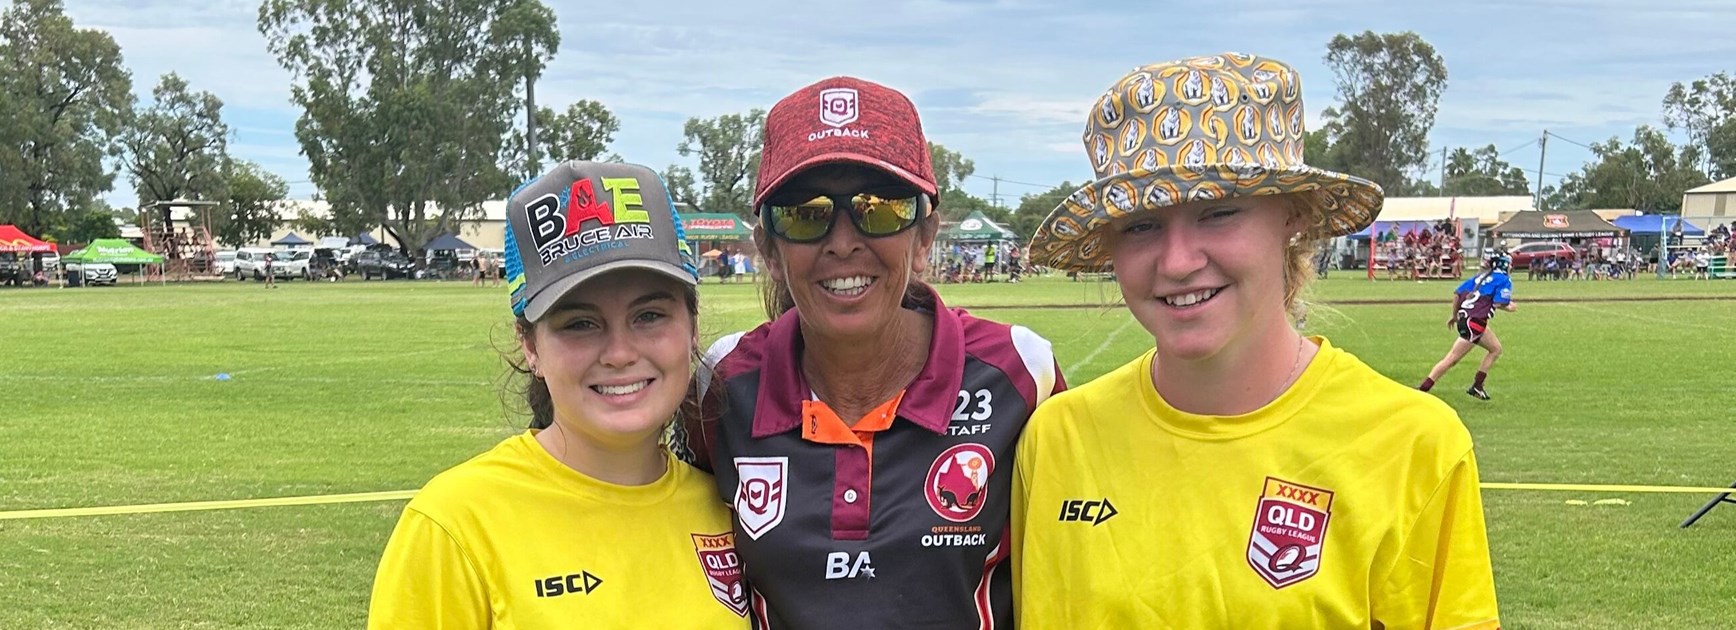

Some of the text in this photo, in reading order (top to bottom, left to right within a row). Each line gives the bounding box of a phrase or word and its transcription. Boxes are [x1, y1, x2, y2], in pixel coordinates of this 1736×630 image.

[808, 127, 869, 141] OUTBACK
[525, 176, 649, 252] BAE
[690, 219, 735, 229] TOYOTA
[540, 224, 653, 267] BRUCE AIR
[572, 240, 630, 260] ELECTRICAL
[1461, 290, 1480, 309] 2
[951, 389, 992, 421] 23
[944, 424, 991, 436] TAFF
[1276, 484, 1319, 506] XXXX
[1267, 505, 1315, 532] QLD
[700, 536, 731, 548] XXXX
[921, 533, 986, 547] OUTBACK
[1261, 525, 1316, 543] RUGBY LEAGUE
[706, 552, 738, 569] QLD
[725, 569, 740, 577] LEAG
